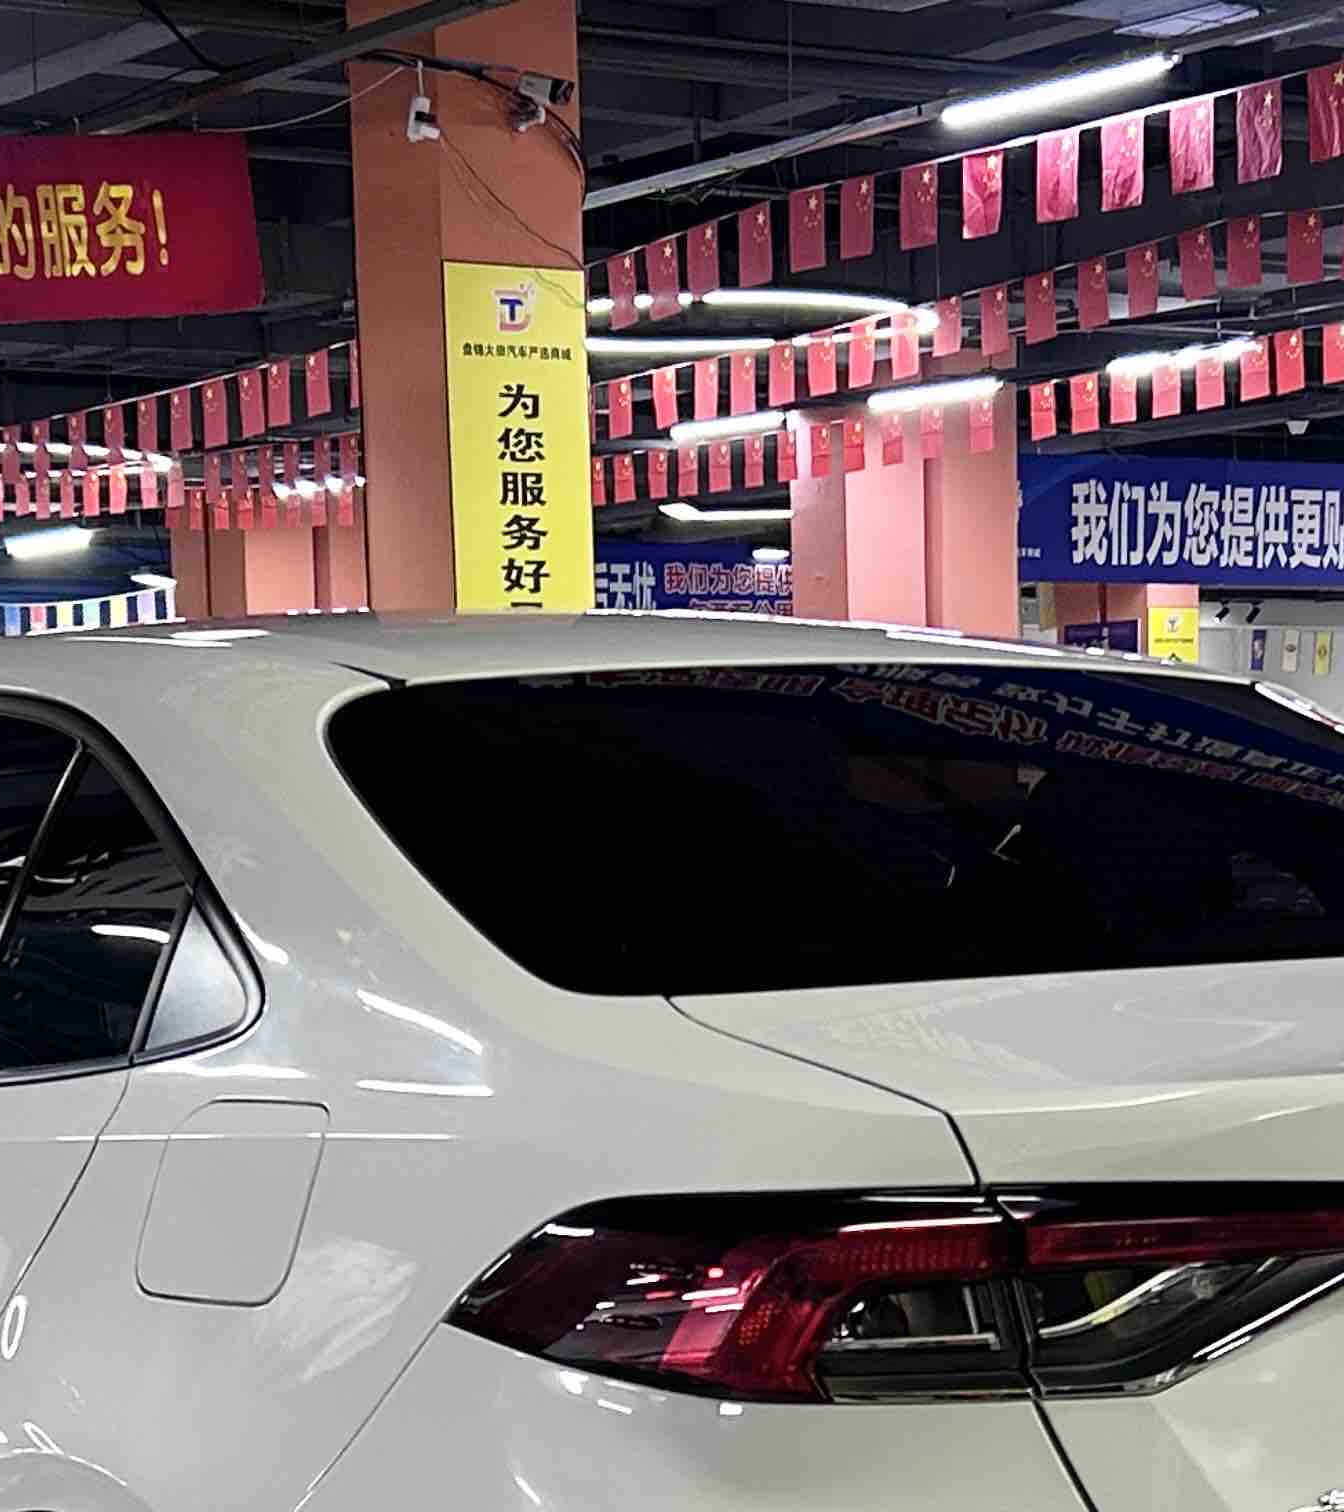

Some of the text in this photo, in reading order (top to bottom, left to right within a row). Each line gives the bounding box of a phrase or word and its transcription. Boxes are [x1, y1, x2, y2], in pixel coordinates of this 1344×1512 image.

[498, 383, 551, 609] 为您服务好
